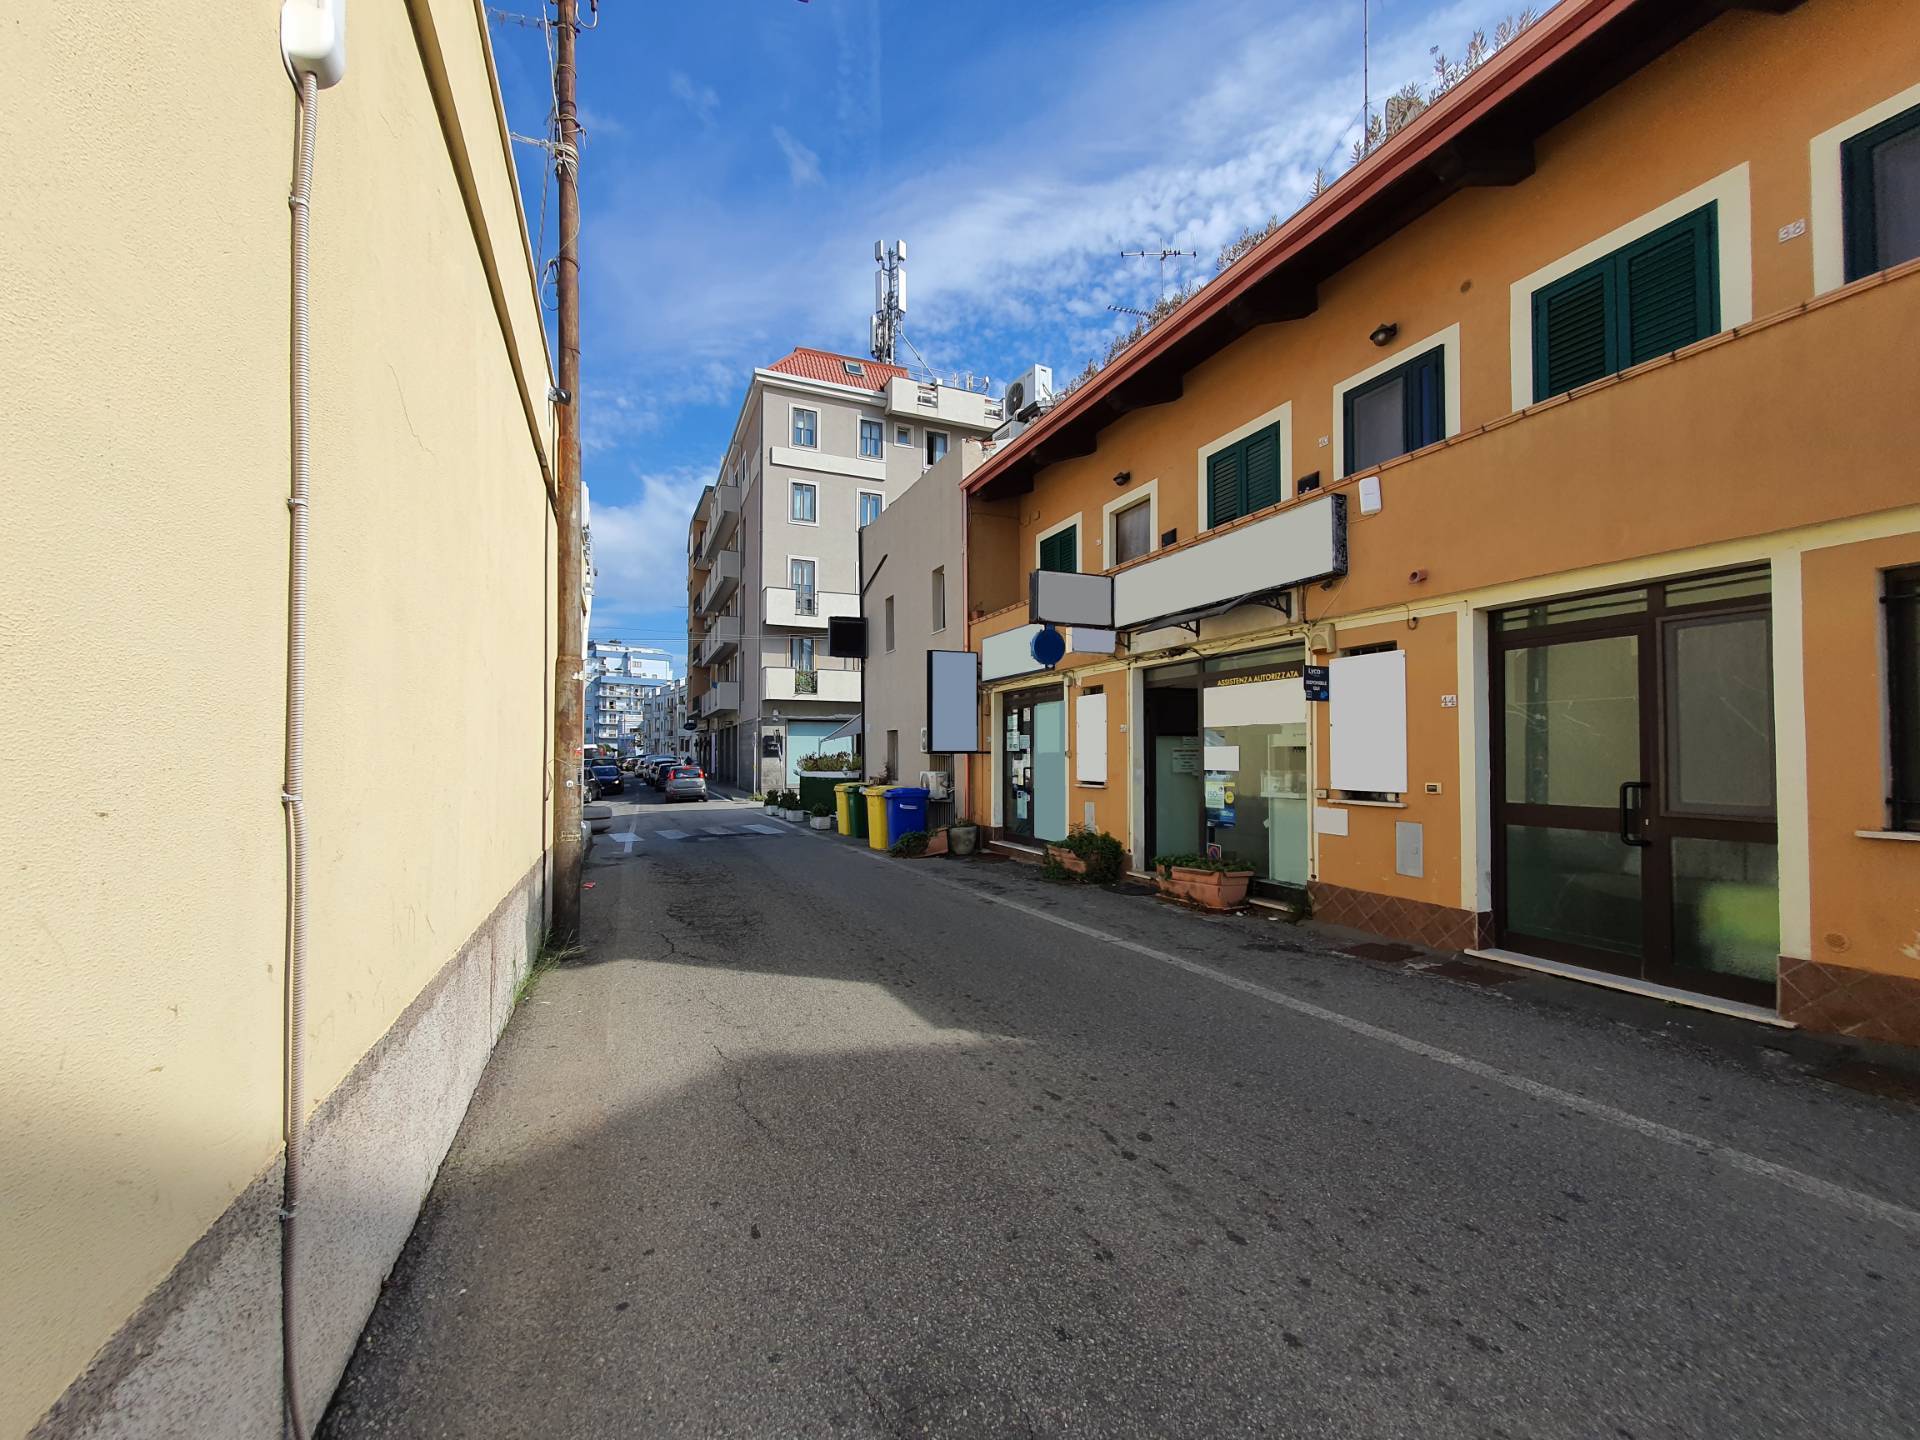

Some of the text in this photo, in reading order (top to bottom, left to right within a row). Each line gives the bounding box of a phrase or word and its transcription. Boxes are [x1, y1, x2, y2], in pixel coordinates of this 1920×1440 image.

[1217, 670, 1299, 687] ASSISTENZA AUTORIZZATA
[1441, 695, 1456, 706] 44
